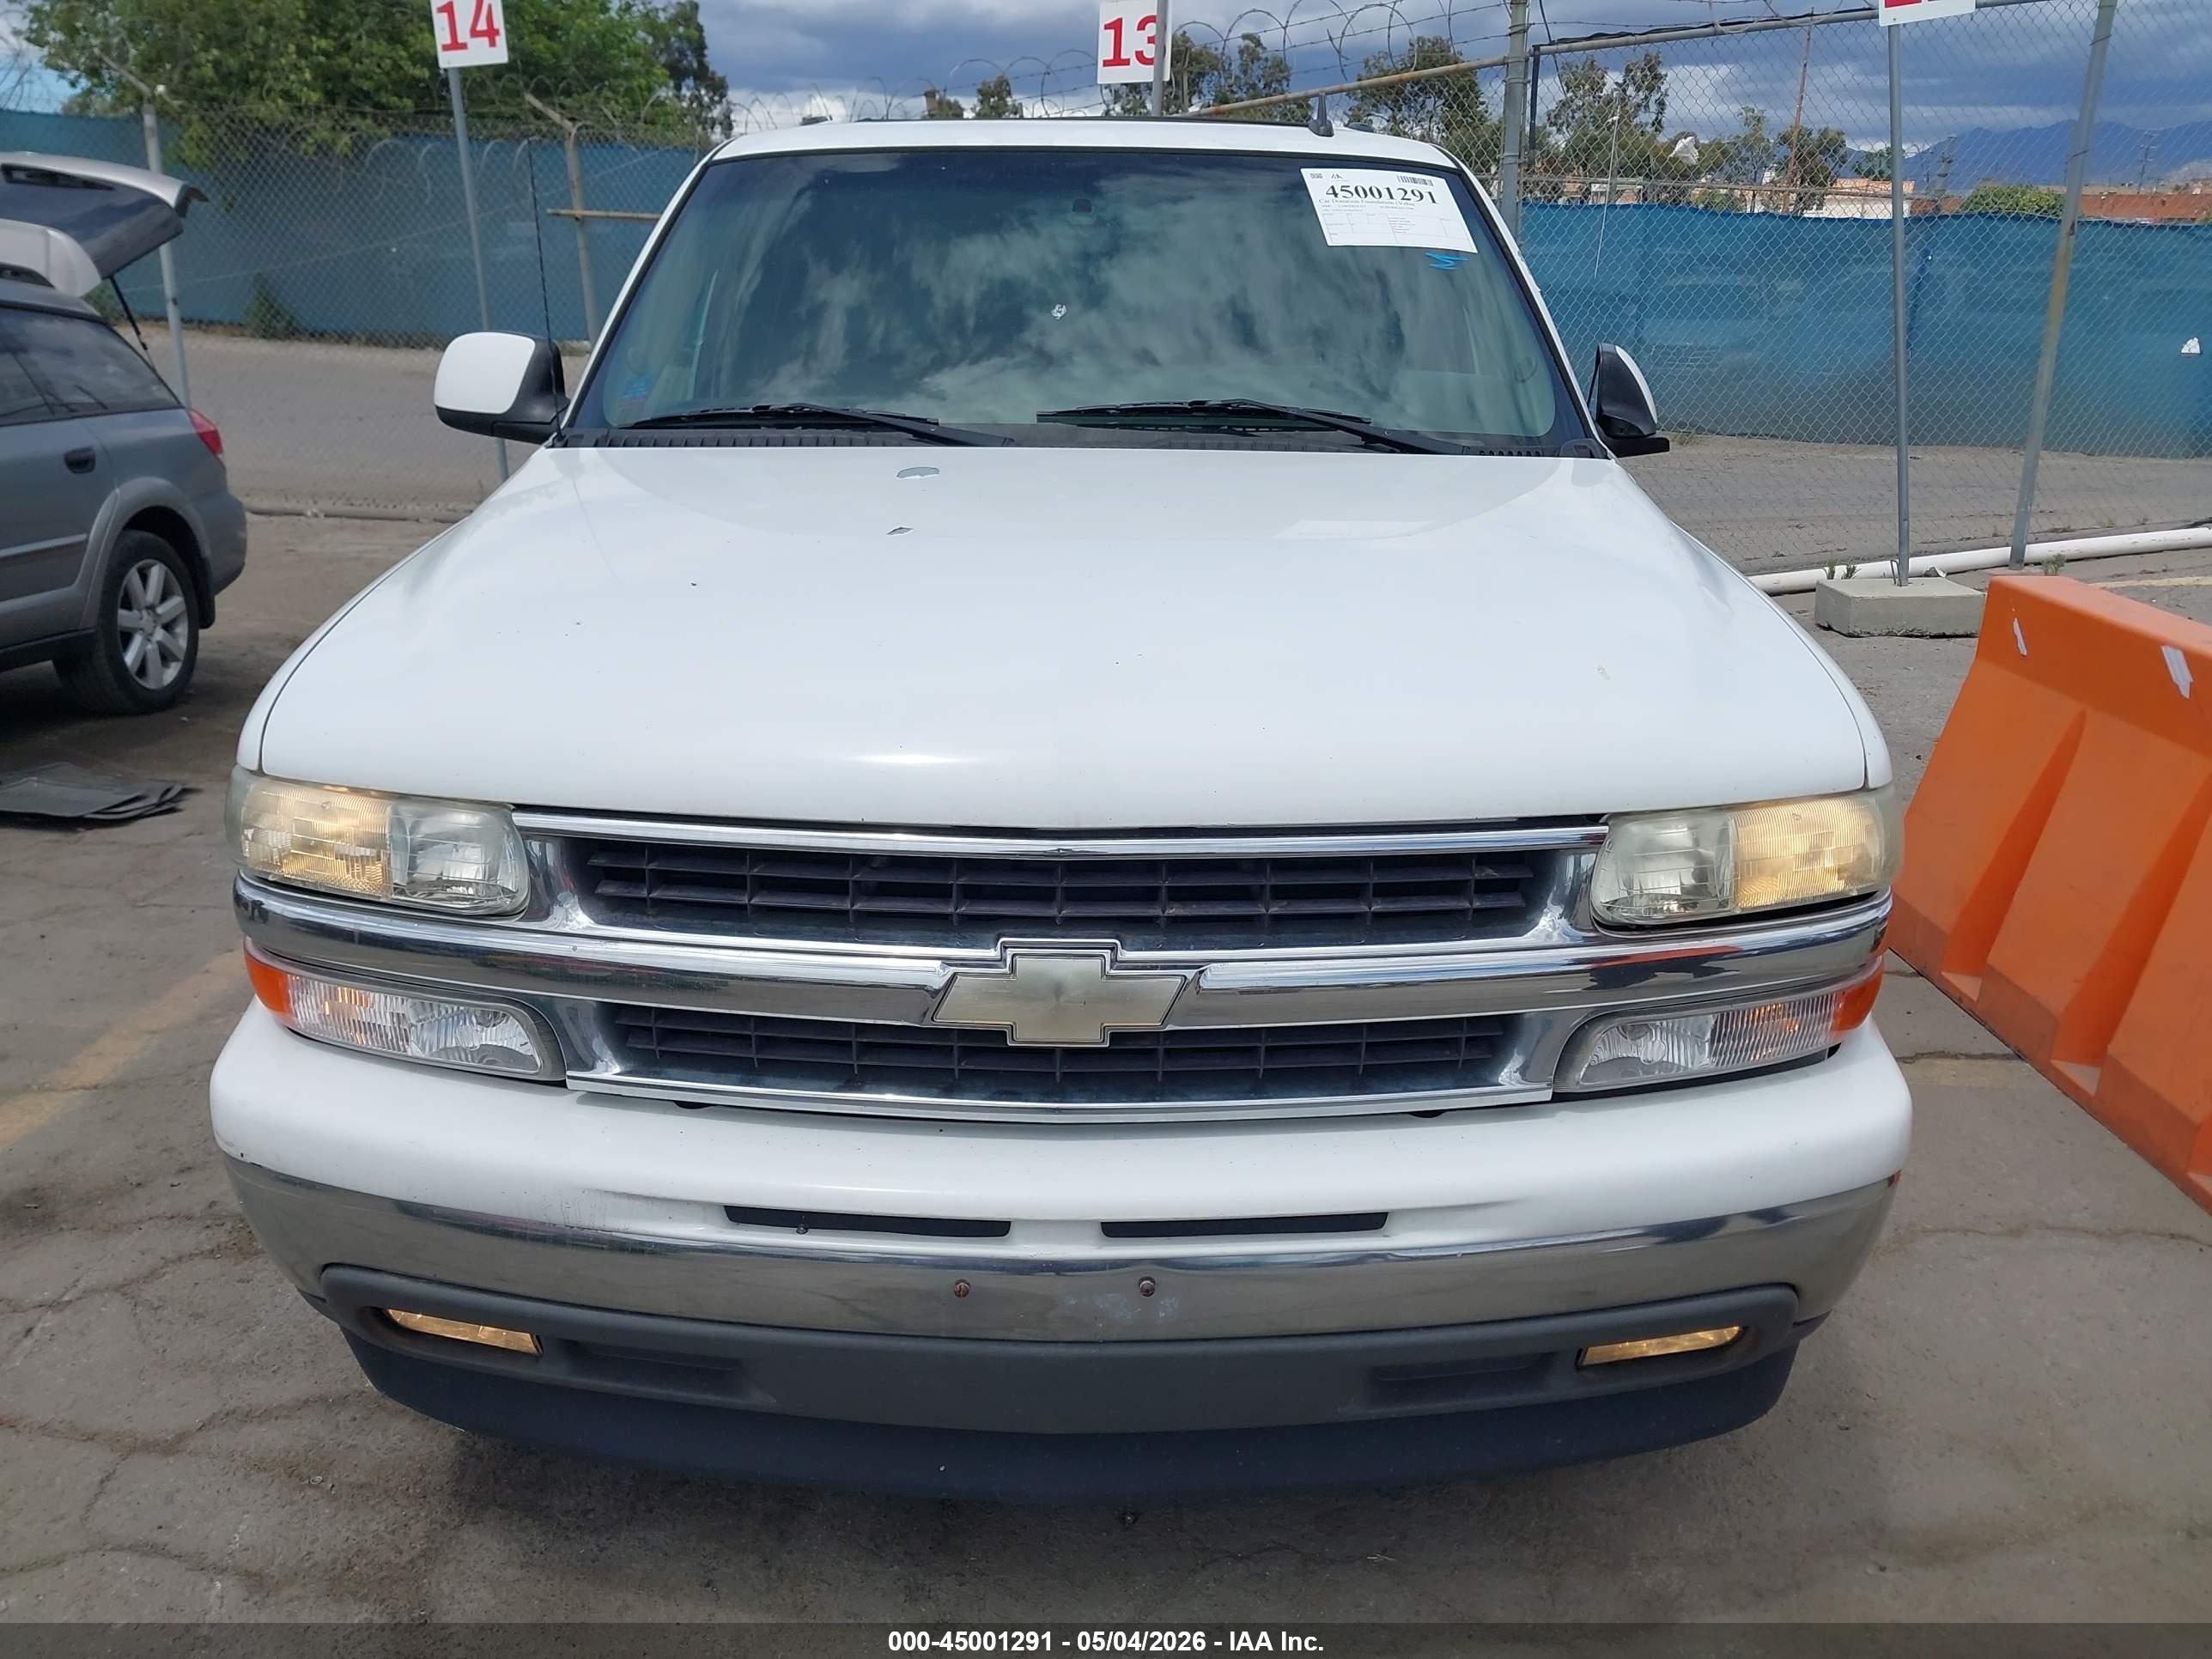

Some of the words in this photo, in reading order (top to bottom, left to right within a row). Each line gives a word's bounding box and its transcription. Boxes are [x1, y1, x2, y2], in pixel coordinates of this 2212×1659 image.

[436, 0, 500, 51] 14
[1102, 15, 1166, 67] 13
[1325, 185, 1438, 204] 45001291
